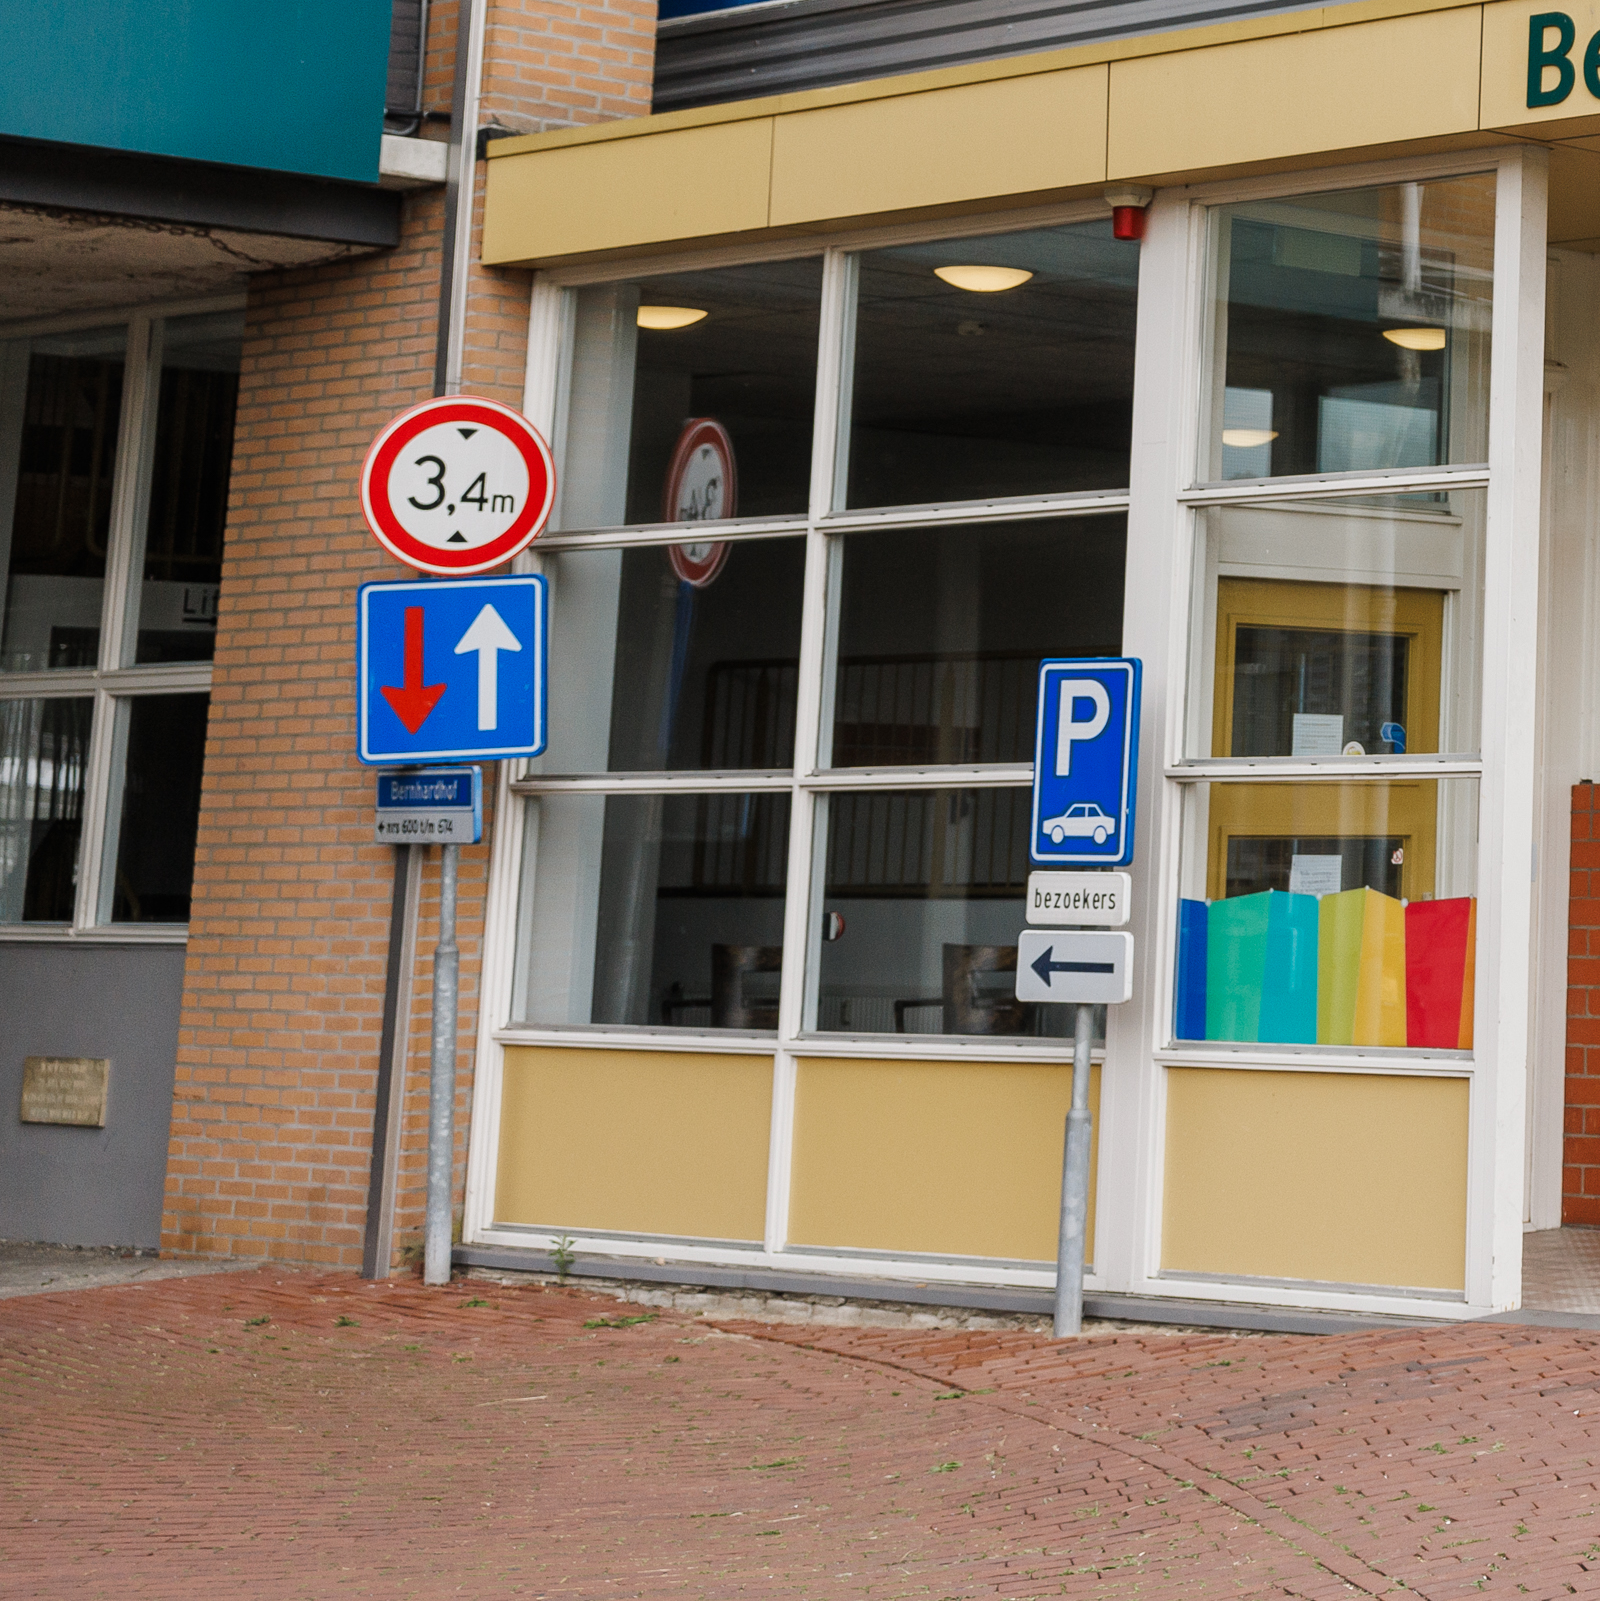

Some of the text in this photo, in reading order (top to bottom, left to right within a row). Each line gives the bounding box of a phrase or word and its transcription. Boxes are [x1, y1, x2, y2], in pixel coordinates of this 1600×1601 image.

[408, 454, 515, 517] 3,4m
[1055, 678, 1111, 777] P
[1034, 888, 1116, 911] bezoekers
